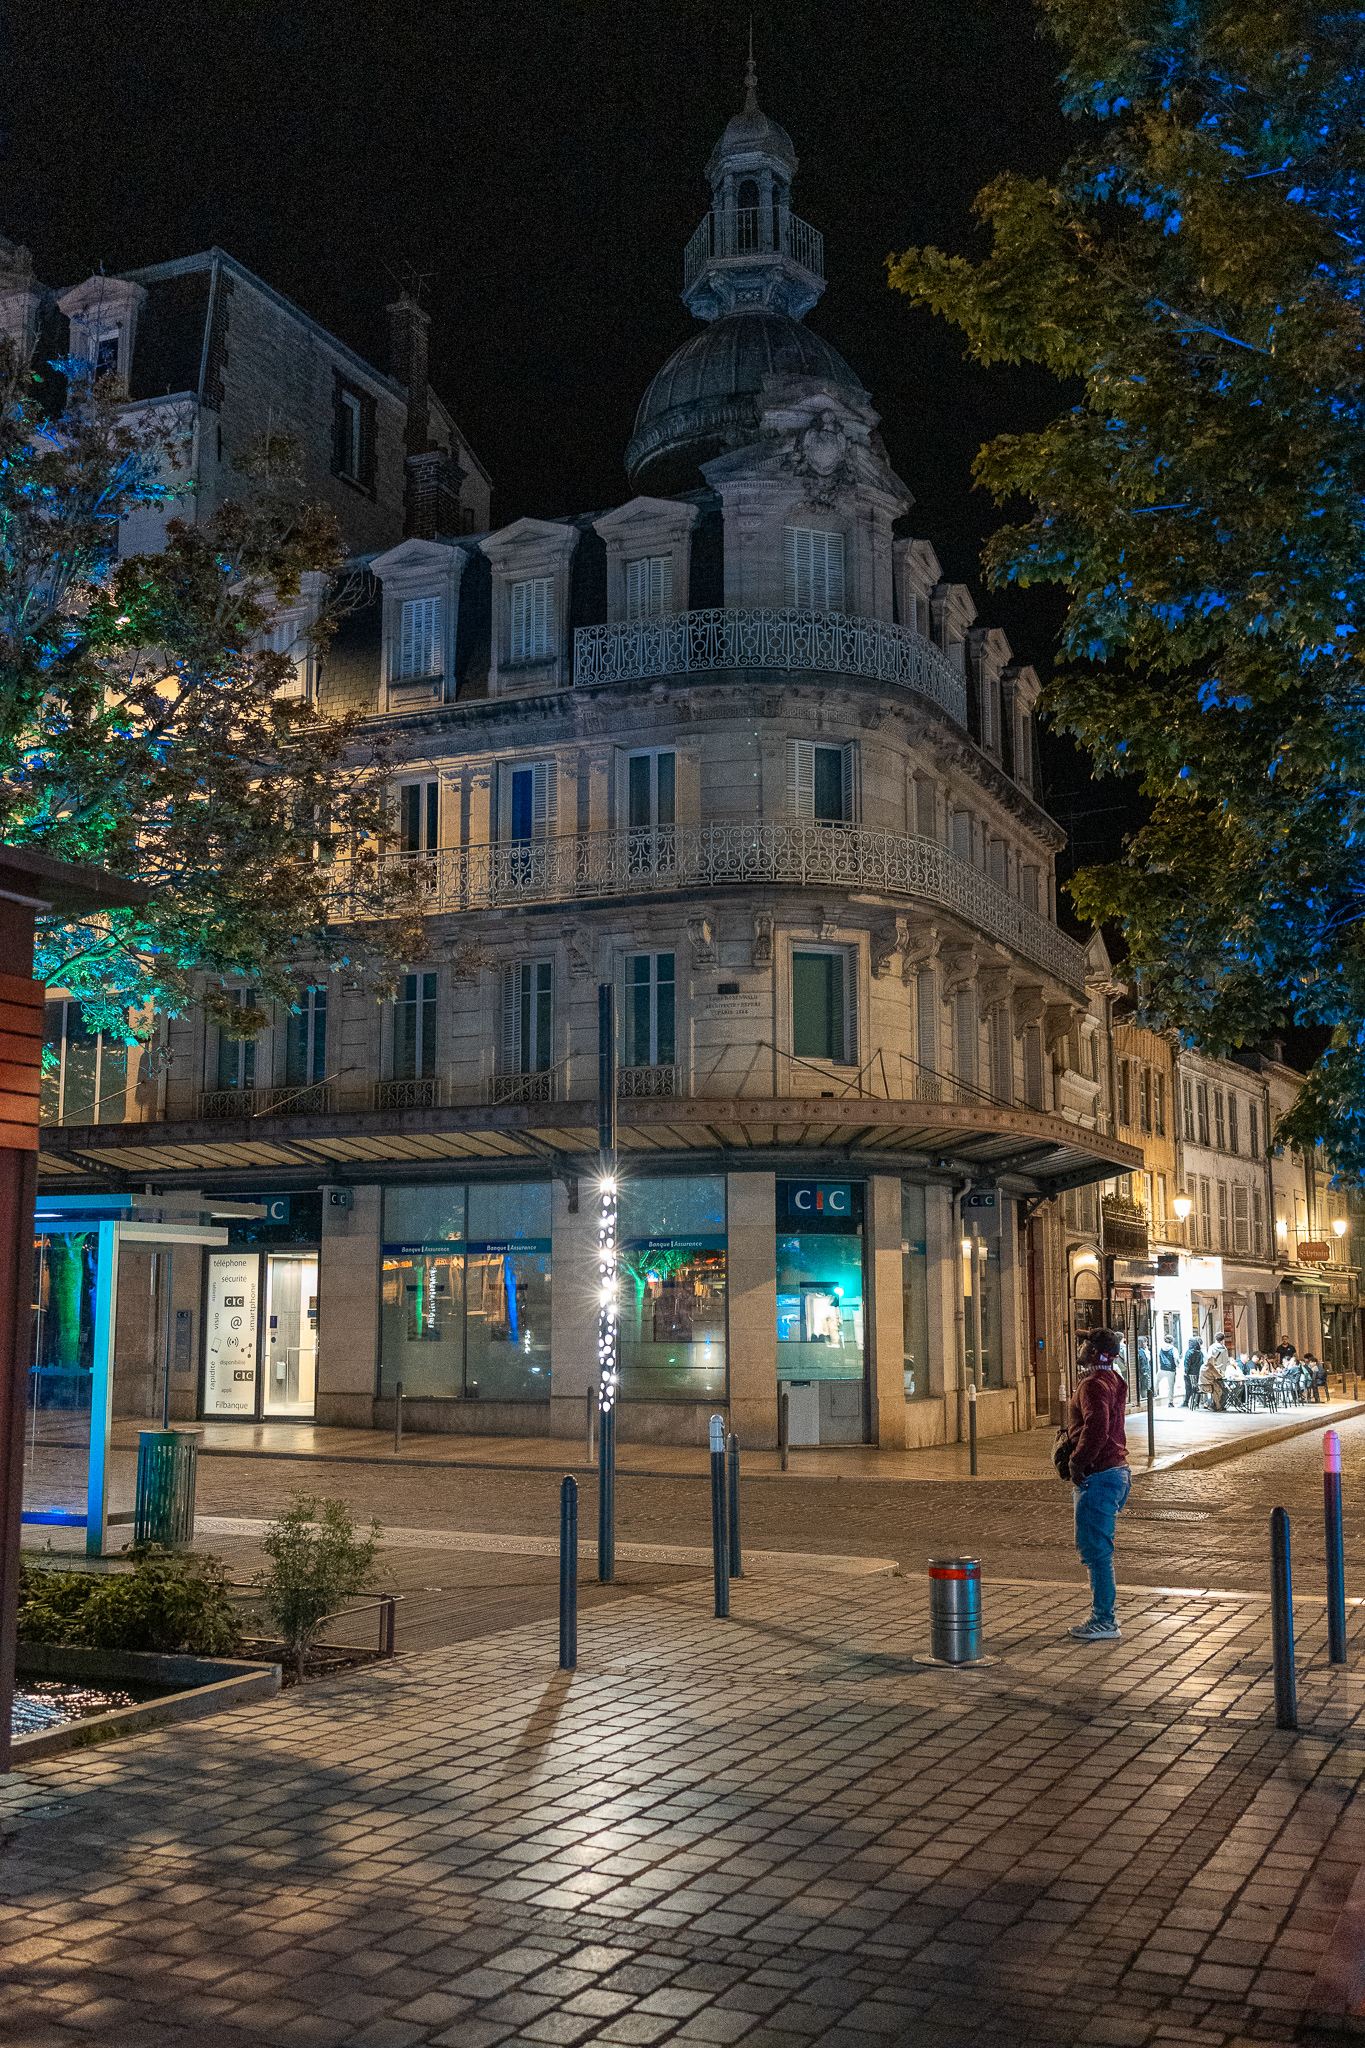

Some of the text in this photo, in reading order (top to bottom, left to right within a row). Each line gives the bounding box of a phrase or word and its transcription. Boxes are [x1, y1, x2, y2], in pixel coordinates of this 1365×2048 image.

[331, 1194, 346, 1204] CC
[795, 1190, 845, 1210] CIC
[213, 1259, 247, 1268] téléphone
[221, 1274, 247, 1283] sécurité
[225, 1297, 243, 1306] CIC
[249, 1283, 257, 1332] smartphone
[235, 1371, 253, 1380] CIC
[215, 1401, 248, 1411] Filbanque
